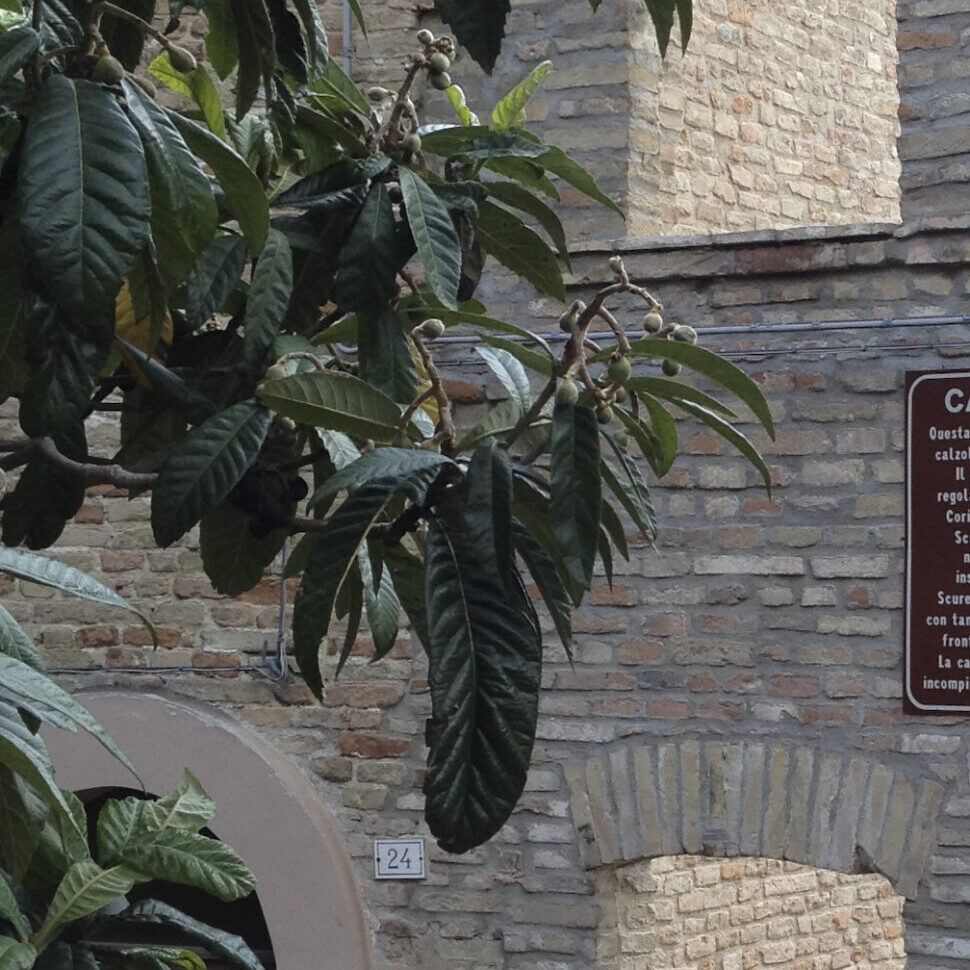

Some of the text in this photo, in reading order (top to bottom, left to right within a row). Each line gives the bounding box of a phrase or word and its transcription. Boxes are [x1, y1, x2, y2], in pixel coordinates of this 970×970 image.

[929, 426, 970, 441] Questa
[955, 466, 966, 481] Il
[926, 616, 947, 626] con
[938, 654, 952, 669] La
[387, 847, 412, 869] 24
